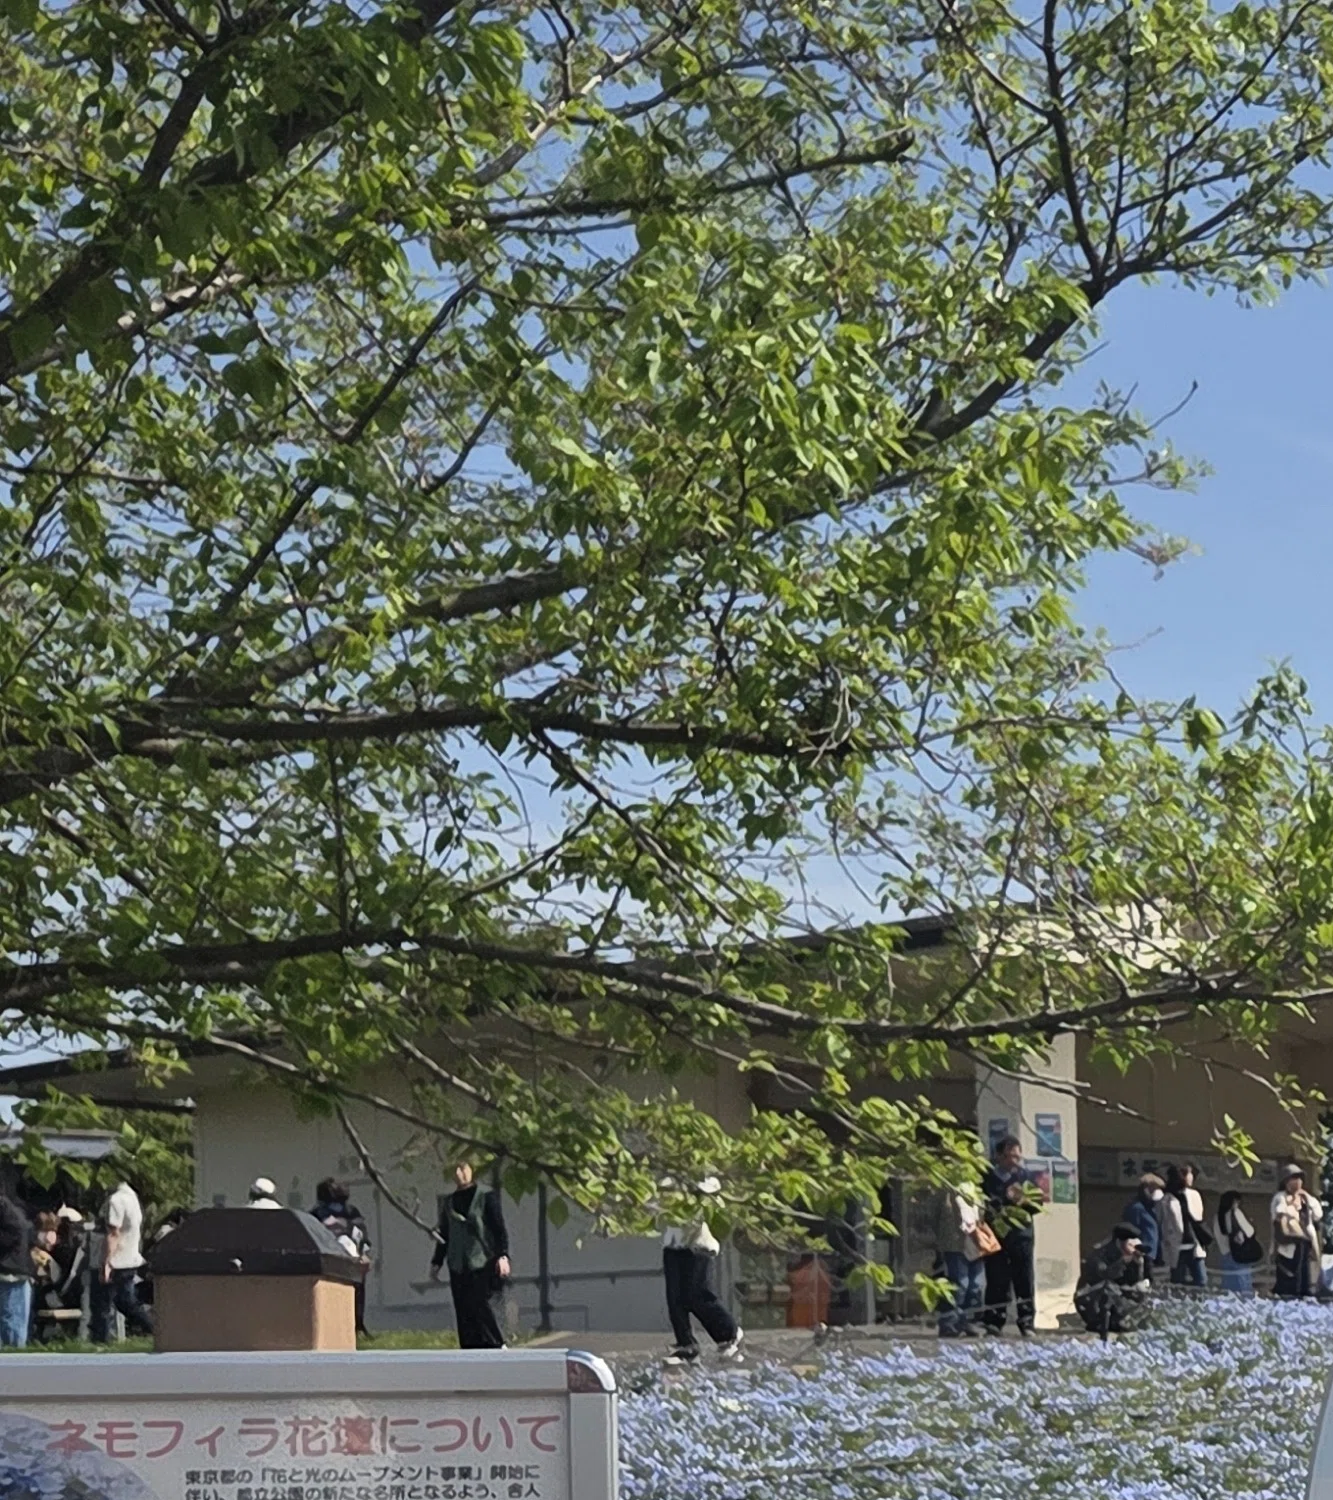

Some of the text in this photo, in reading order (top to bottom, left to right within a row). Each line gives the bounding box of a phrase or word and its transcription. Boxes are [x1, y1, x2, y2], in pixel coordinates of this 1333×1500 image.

[46, 1415, 560, 1460] ネモフィラ花壇について
